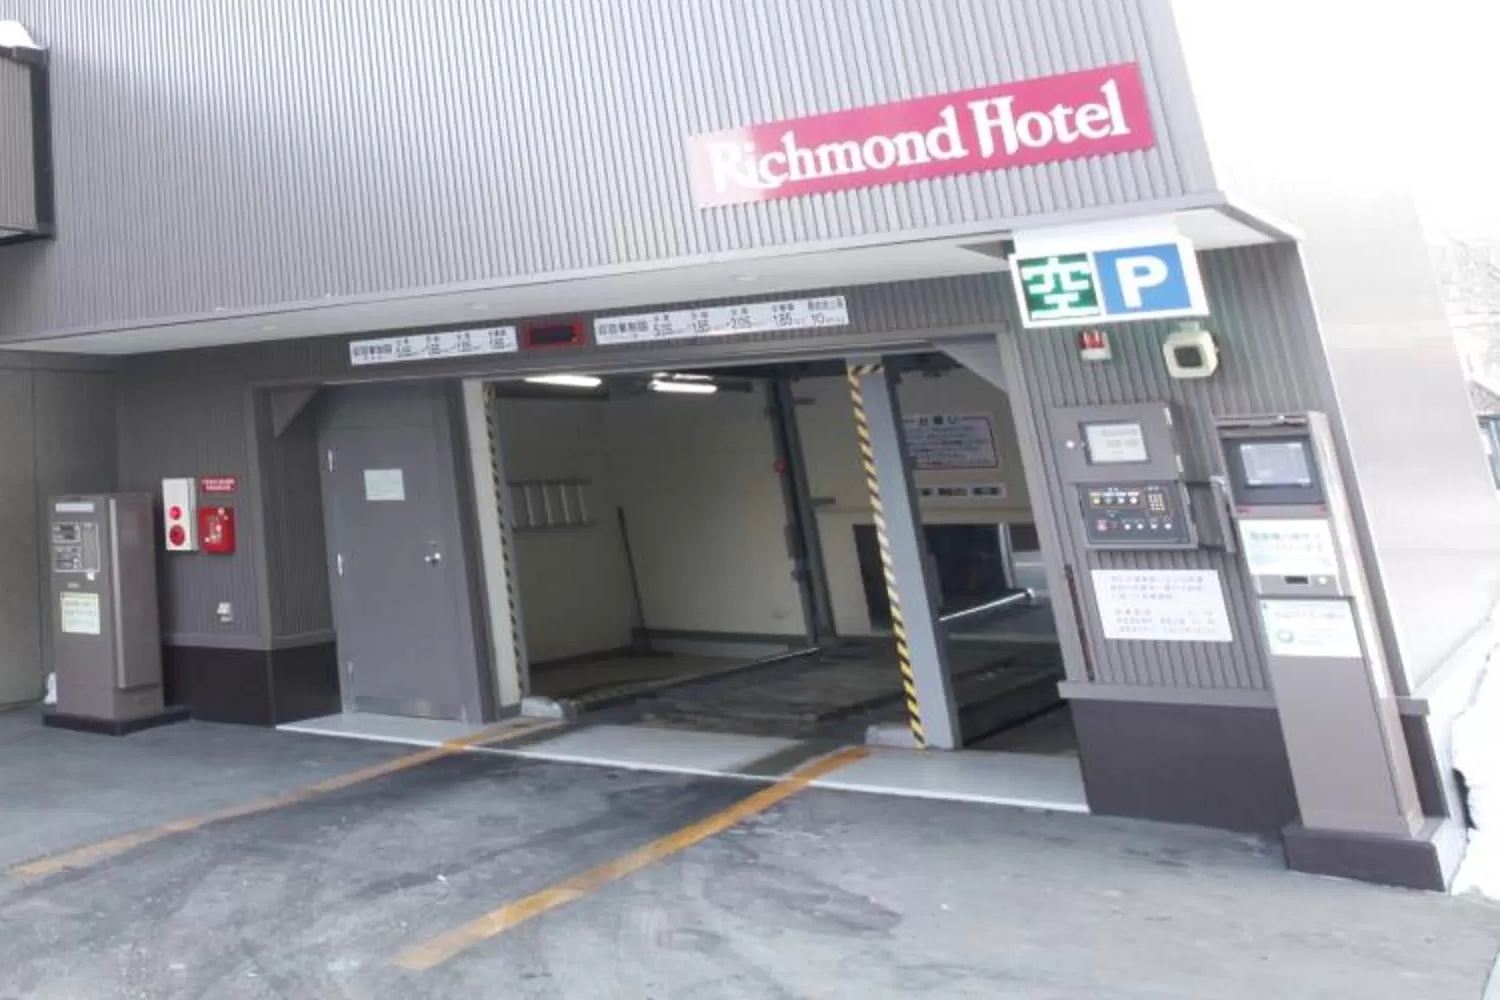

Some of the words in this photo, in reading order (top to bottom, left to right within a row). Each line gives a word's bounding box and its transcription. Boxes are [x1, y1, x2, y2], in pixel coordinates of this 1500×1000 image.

[708, 105, 968, 194] Richmond
[968, 79, 1130, 159] Hotel
[1021, 256, 1100, 321] 空
[1115, 255, 1168, 309] P
